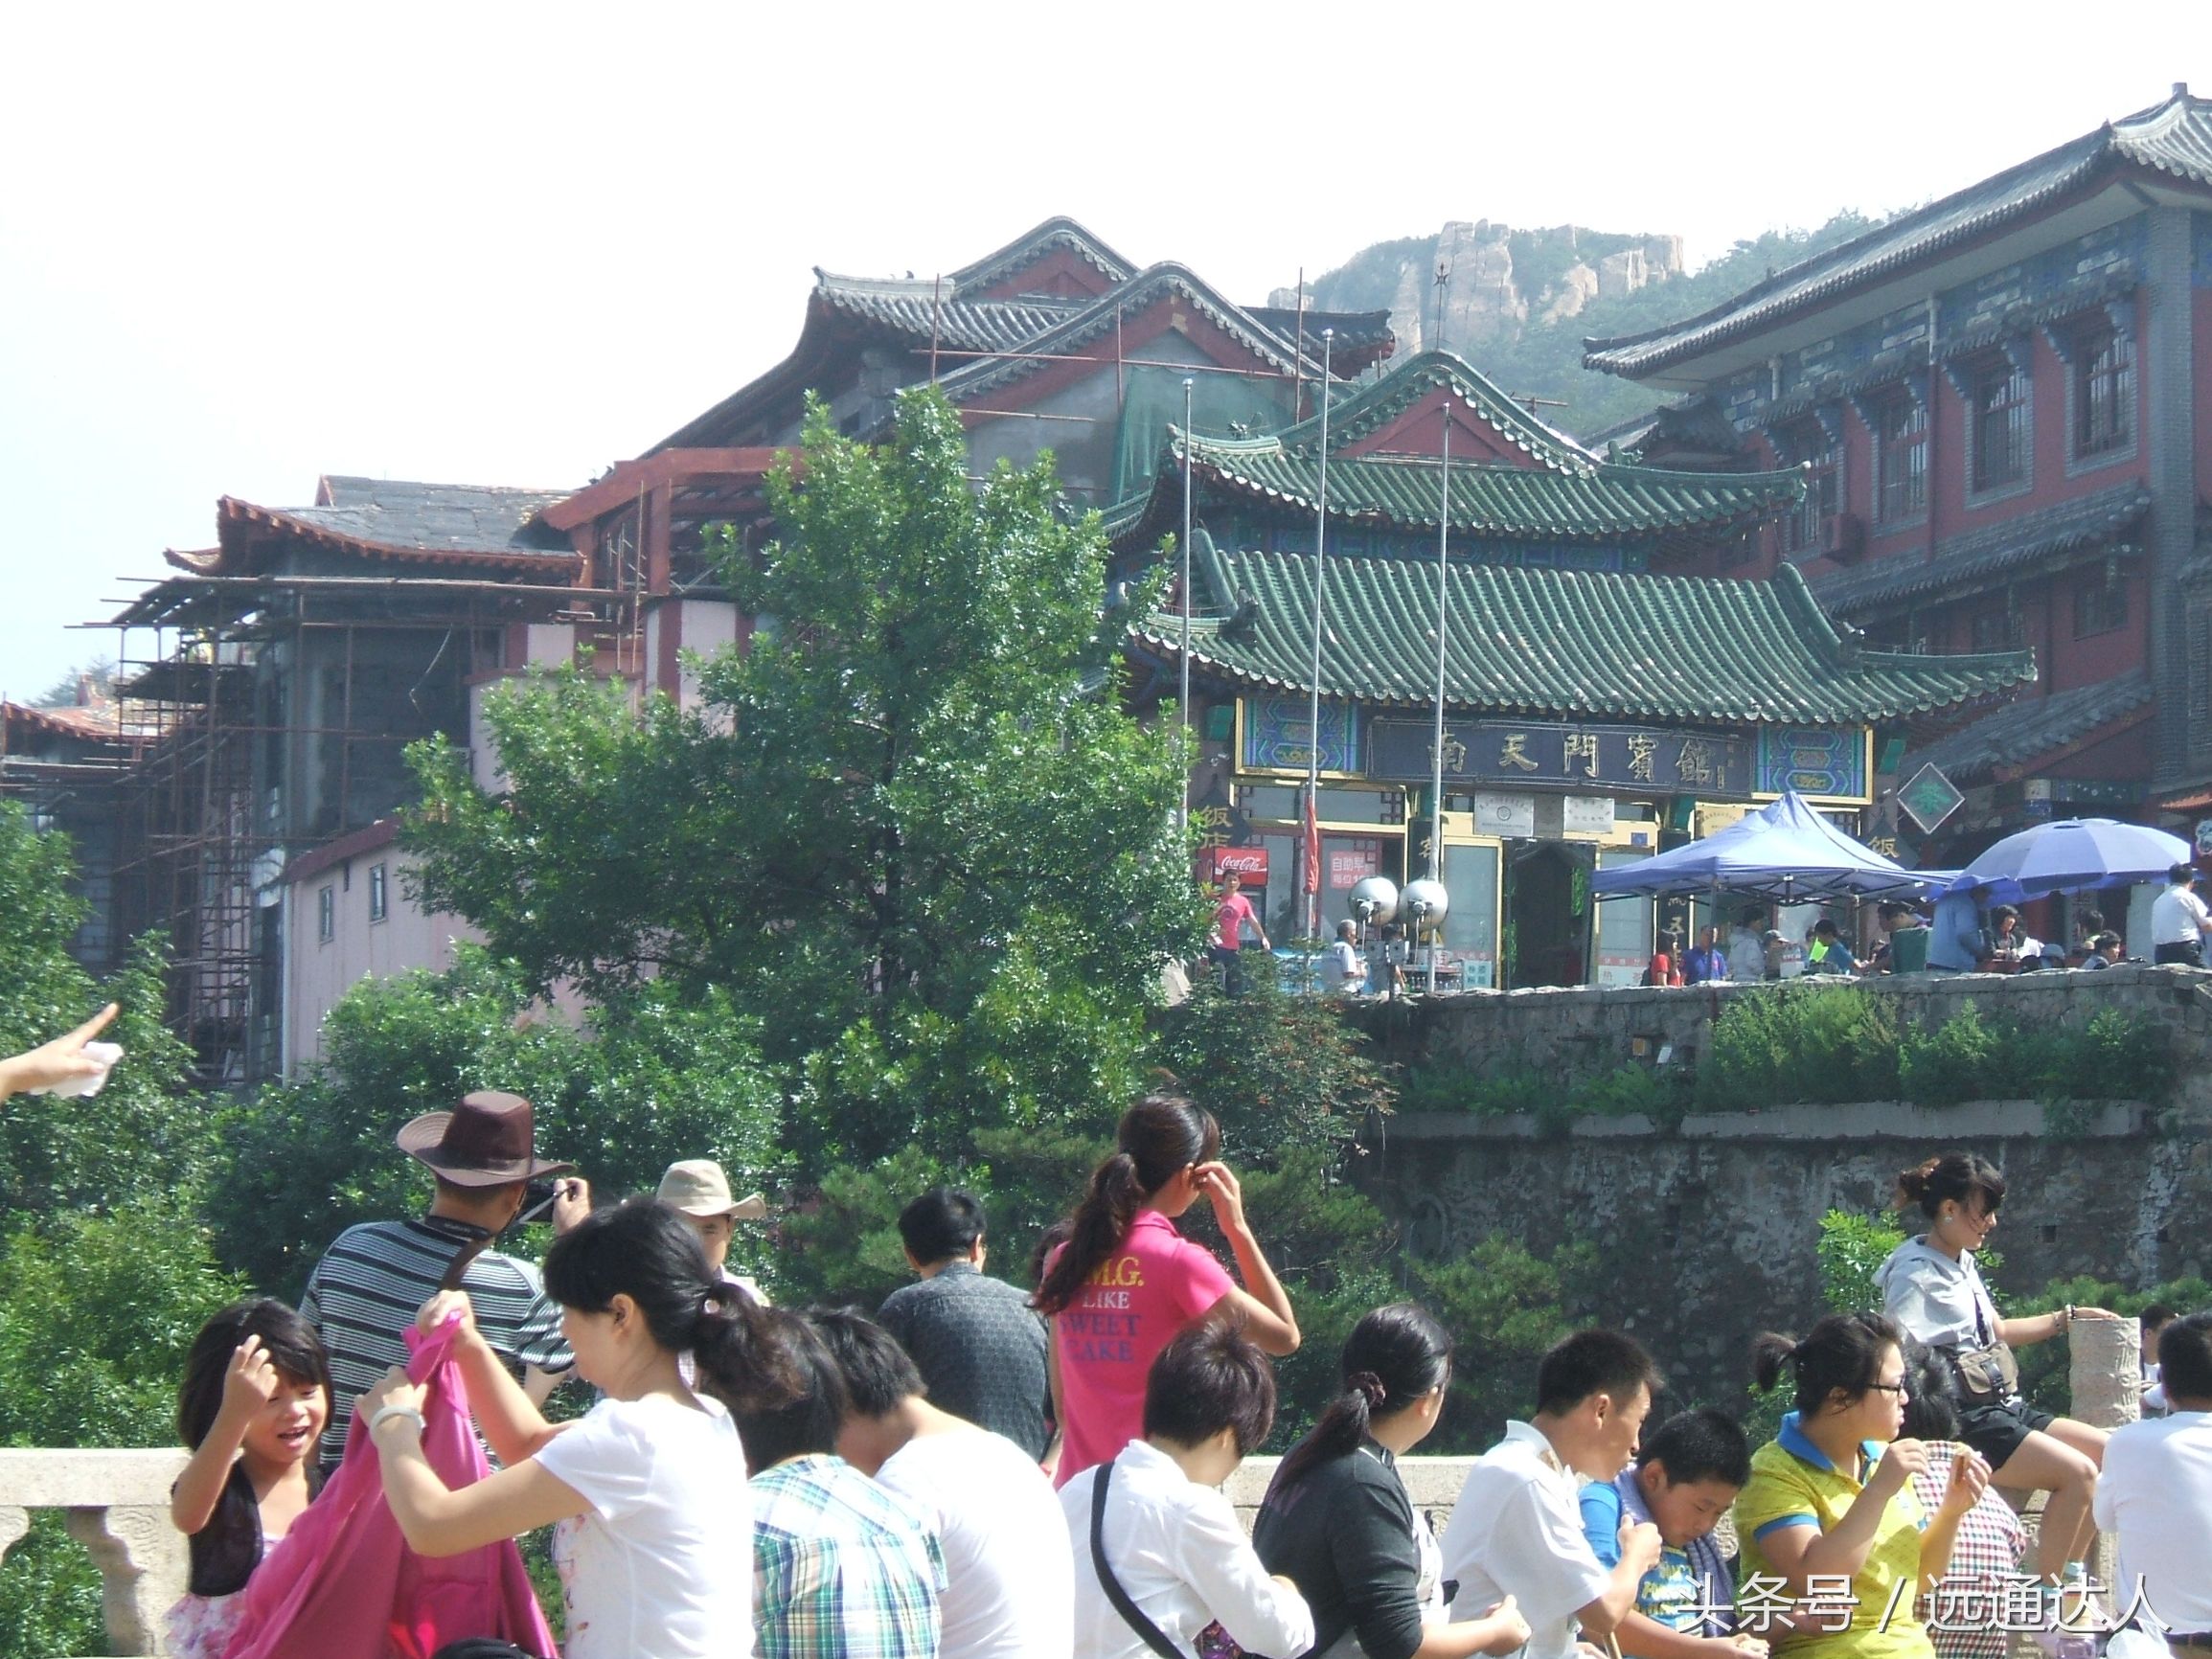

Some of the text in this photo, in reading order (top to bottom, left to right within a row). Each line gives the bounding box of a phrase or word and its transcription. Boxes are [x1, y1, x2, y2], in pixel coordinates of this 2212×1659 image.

[1427, 726, 1716, 784] 南天門賓館
[1333, 856, 1374, 873] 自助早
[1082, 1291, 1130, 1309] LIKE
[1064, 1339, 1134, 1364] CAKE
